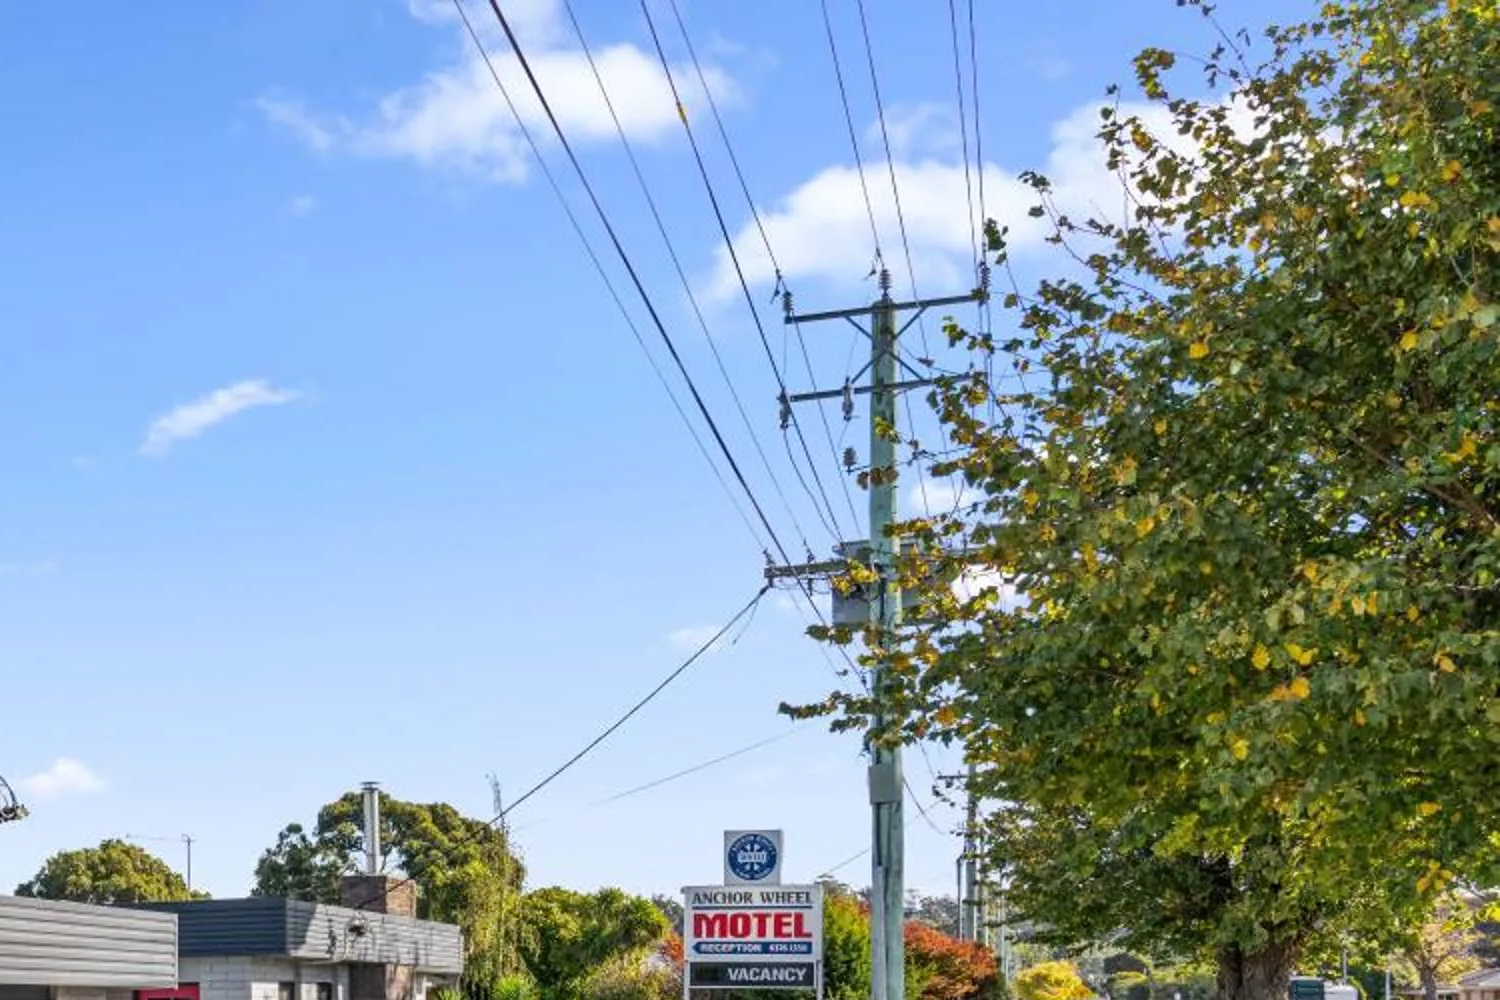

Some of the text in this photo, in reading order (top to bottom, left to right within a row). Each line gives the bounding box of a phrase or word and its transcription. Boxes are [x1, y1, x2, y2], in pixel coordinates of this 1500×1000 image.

[692, 891, 813, 904] ANCHOR WHEEL
[693, 912, 813, 938] MOTEL
[699, 944, 762, 952] RECEPTION
[728, 967, 807, 981] VACANCY
